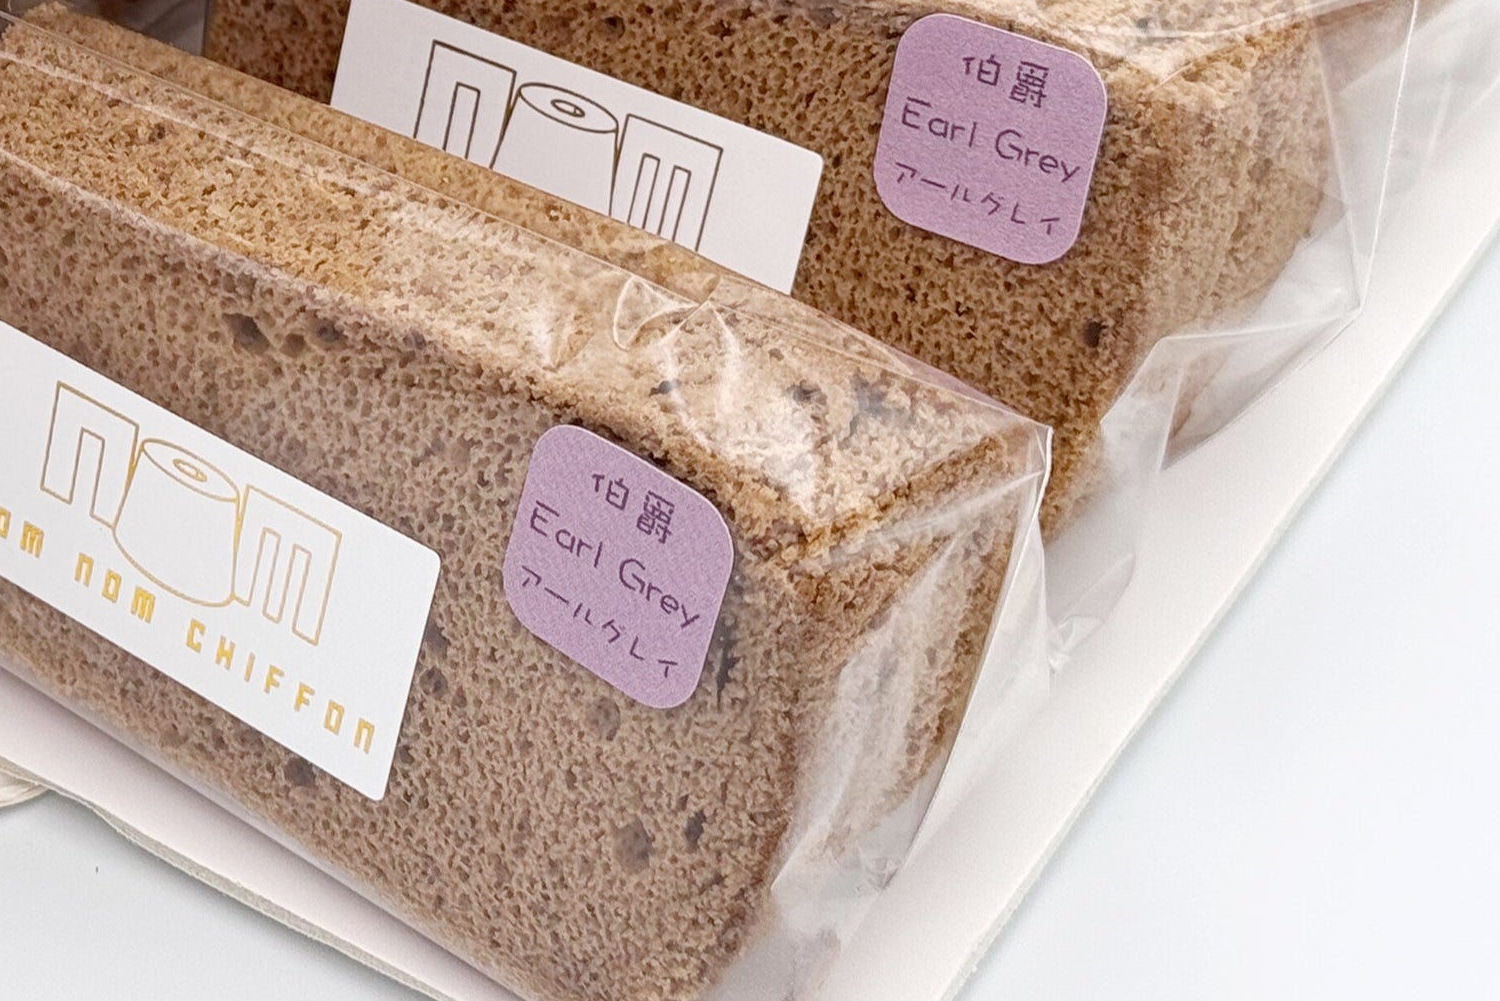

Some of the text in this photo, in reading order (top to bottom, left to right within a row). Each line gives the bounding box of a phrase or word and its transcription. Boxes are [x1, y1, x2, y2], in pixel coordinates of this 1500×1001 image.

[962, 54, 1049, 109] 伯爵
[901, 96, 1081, 183] Earl Grey
[895, 161, 1061, 235] アールグレイ
[591, 474, 675, 544] 伯爵
[529, 500, 700, 629] Earl Grey
[521, 565, 678, 678] アールグレイ
